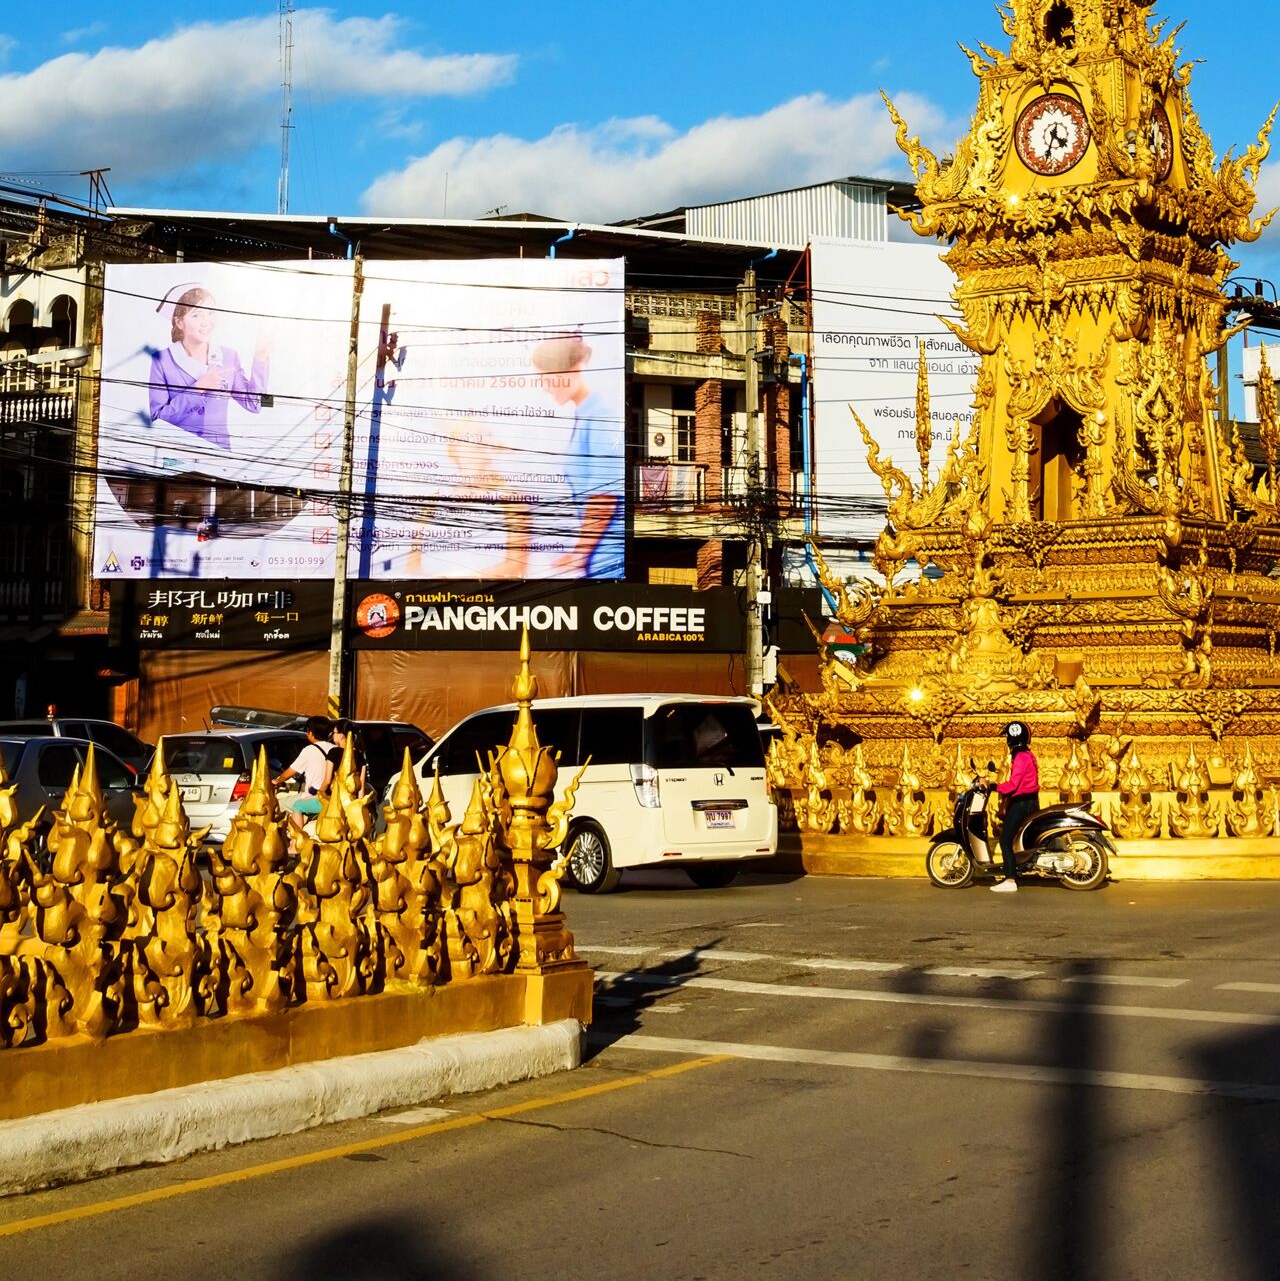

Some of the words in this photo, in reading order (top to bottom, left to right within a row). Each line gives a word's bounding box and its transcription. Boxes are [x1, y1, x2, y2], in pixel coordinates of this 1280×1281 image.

[894, 359, 920, 372] แลนด
[490, 376, 526, 389] 2560
[268, 557, 325, 565] 053-910-999
[148, 589, 293, 610] 邦孔咖啡
[404, 605, 578, 631] PANGKHON
[593, 606, 705, 632] COFFEE
